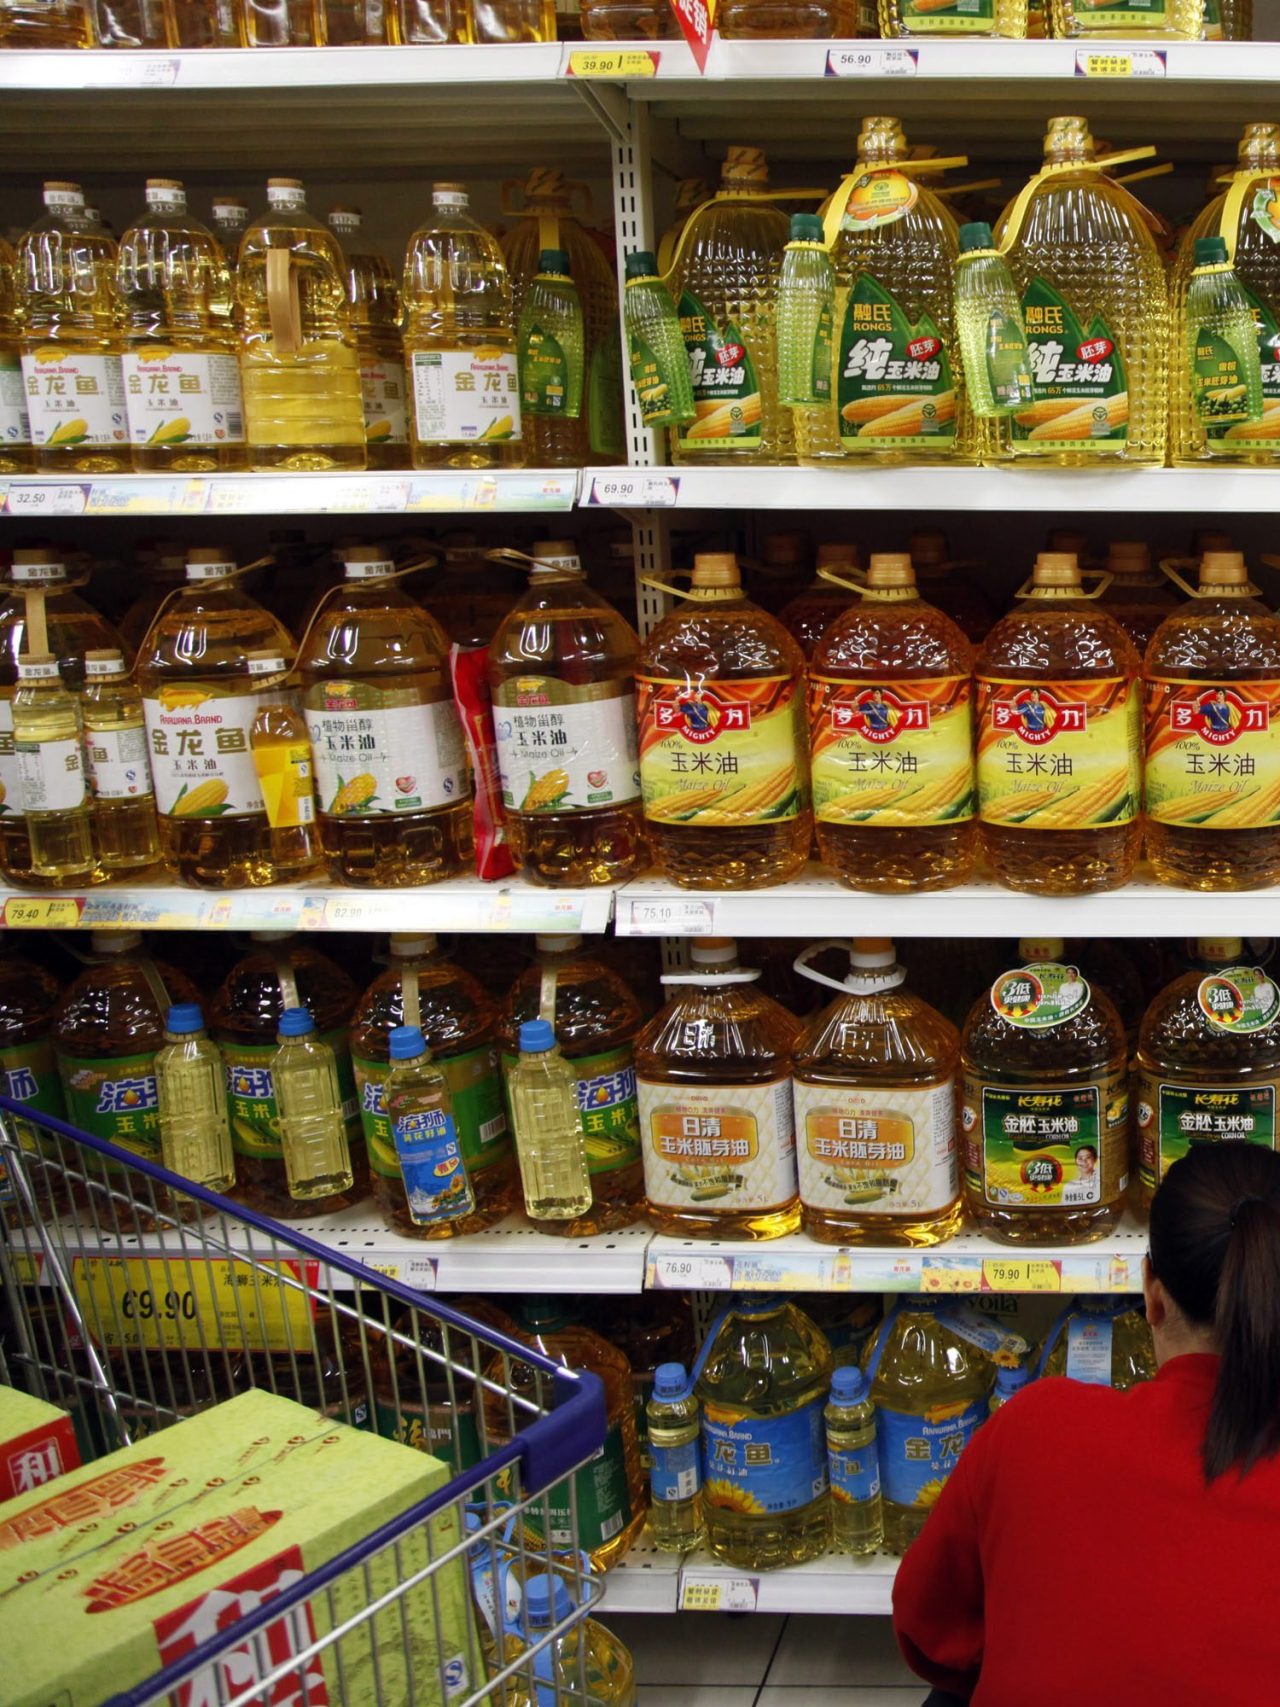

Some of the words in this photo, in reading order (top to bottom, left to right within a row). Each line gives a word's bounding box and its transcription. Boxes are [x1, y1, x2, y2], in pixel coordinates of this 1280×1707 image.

[582, 60, 613, 71] 39.90
[840, 54, 872, 65] 56.90
[853, 303, 891, 322] 融氏
[1025, 305, 1063, 324] 融氏
[853, 322, 894, 332] RONGS
[909, 338, 936, 359] 胚芽
[1080, 341, 1108, 361] 胚芽
[844, 338, 941, 380] 纯玉米油
[27, 374, 100, 395] 金龙鱼
[128, 373, 202, 394] 金龙鱼
[454, 372, 518, 392] 金龙鱼
[604, 482, 634, 494] 69.90
[17, 493, 46, 504] 32.50
[160, 715, 193, 725] ARAWANA
[194, 714, 222, 725] BRAND
[151, 727, 248, 756] 金龙鱼
[517, 730, 567, 747] 玉米油
[681, 724, 716, 741] MIGHTY
[861, 726, 895, 741] MIGHTY
[1018, 726, 1051, 741] MIGHTY
[1201, 727, 1237, 742] MIGHTY
[325, 734, 376, 751] 玉米油
[173, 759, 217, 771] 玉米油
[670, 751, 739, 775] 玉米油
[848, 751, 919, 775] 玉米油
[1005, 752, 1074, 777] 玉米油
[1185, 752, 1256, 777] 玉米油
[11, 908, 39, 920] 79.40
[643, 908, 672, 919] 75.10
[398, 1109, 446, 1133] 海狮
[682, 1117, 722, 1138] 日清
[838, 1118, 878, 1140] 日清
[1004, 1114, 1079, 1134] 金胚玉米油
[1180, 1112, 1254, 1132] 金胚玉米油
[660, 1136, 750, 1157] 玉米胚芽油
[814, 1138, 905, 1160] 玉米胚芽油
[665, 1262, 692, 1274] 76.90
[993, 1268, 1020, 1280] 79.90
[122, 1290, 197, 1320] 69.90
